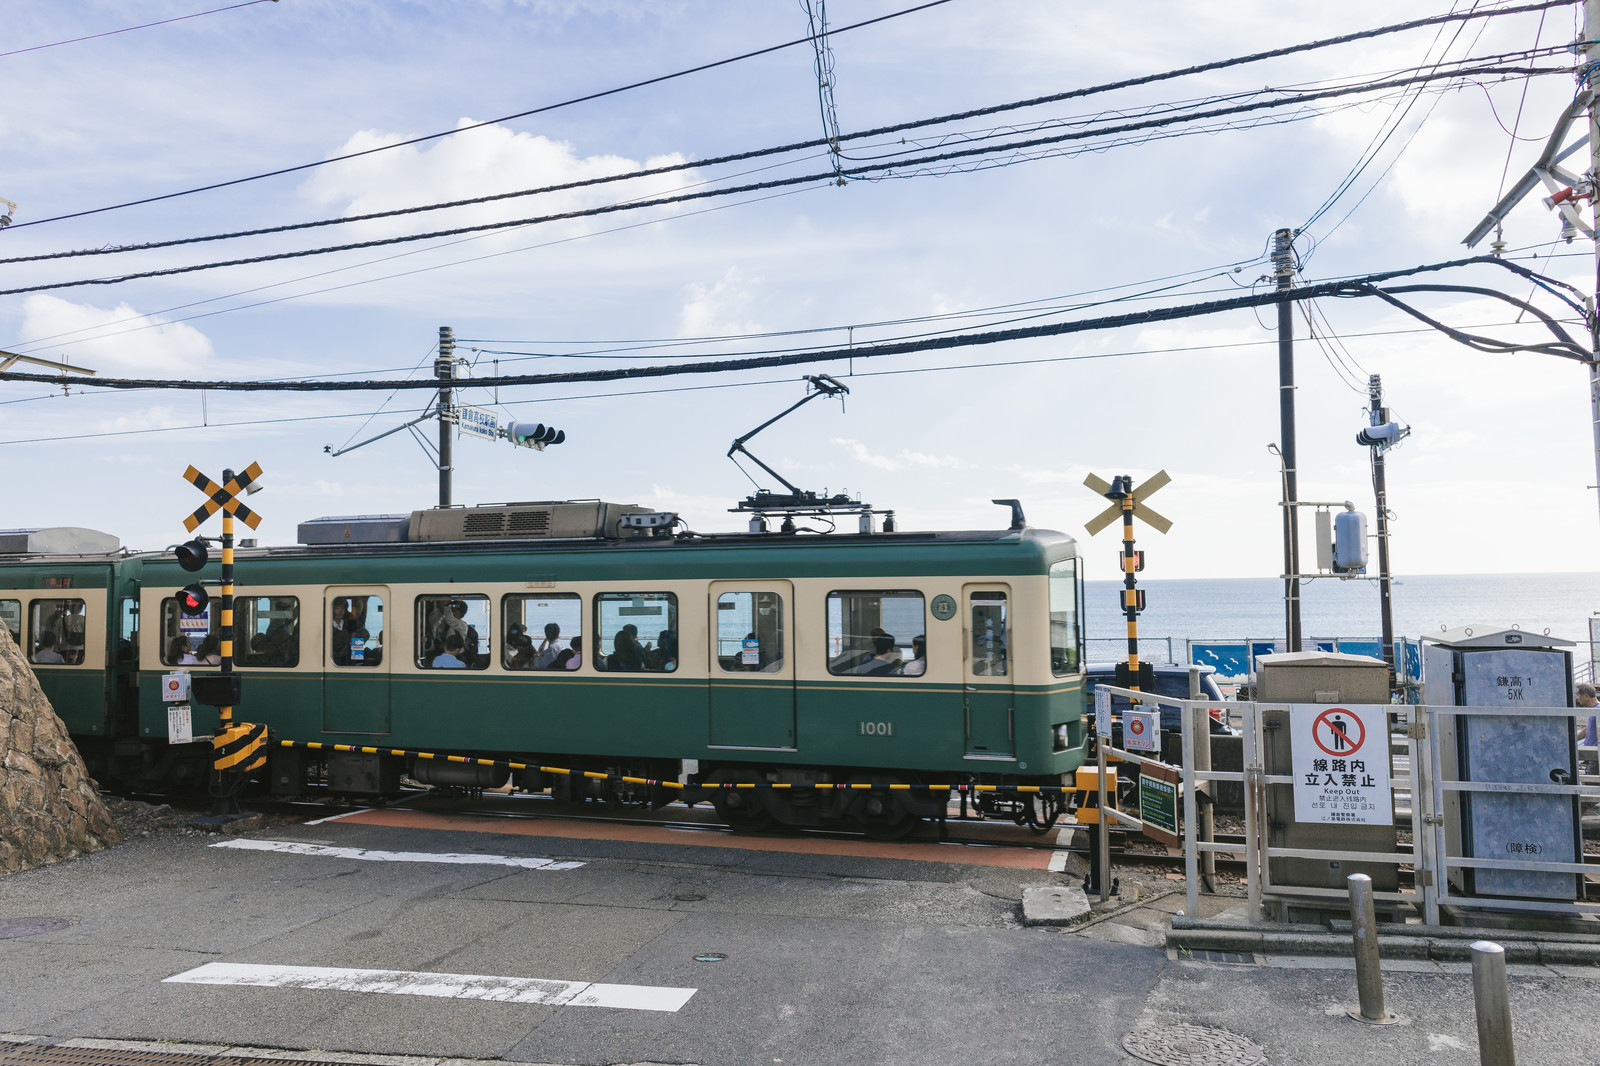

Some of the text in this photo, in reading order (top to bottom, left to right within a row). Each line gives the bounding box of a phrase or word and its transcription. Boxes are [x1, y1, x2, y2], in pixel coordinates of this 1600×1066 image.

[1508, 688, 1524, 700] 5XK
[861, 721, 892, 735] 1001
[1313, 758, 1365, 773] 線路内
[1305, 772, 1376, 787] 立入禁止
[1324, 788, 1343, 796] Keep
